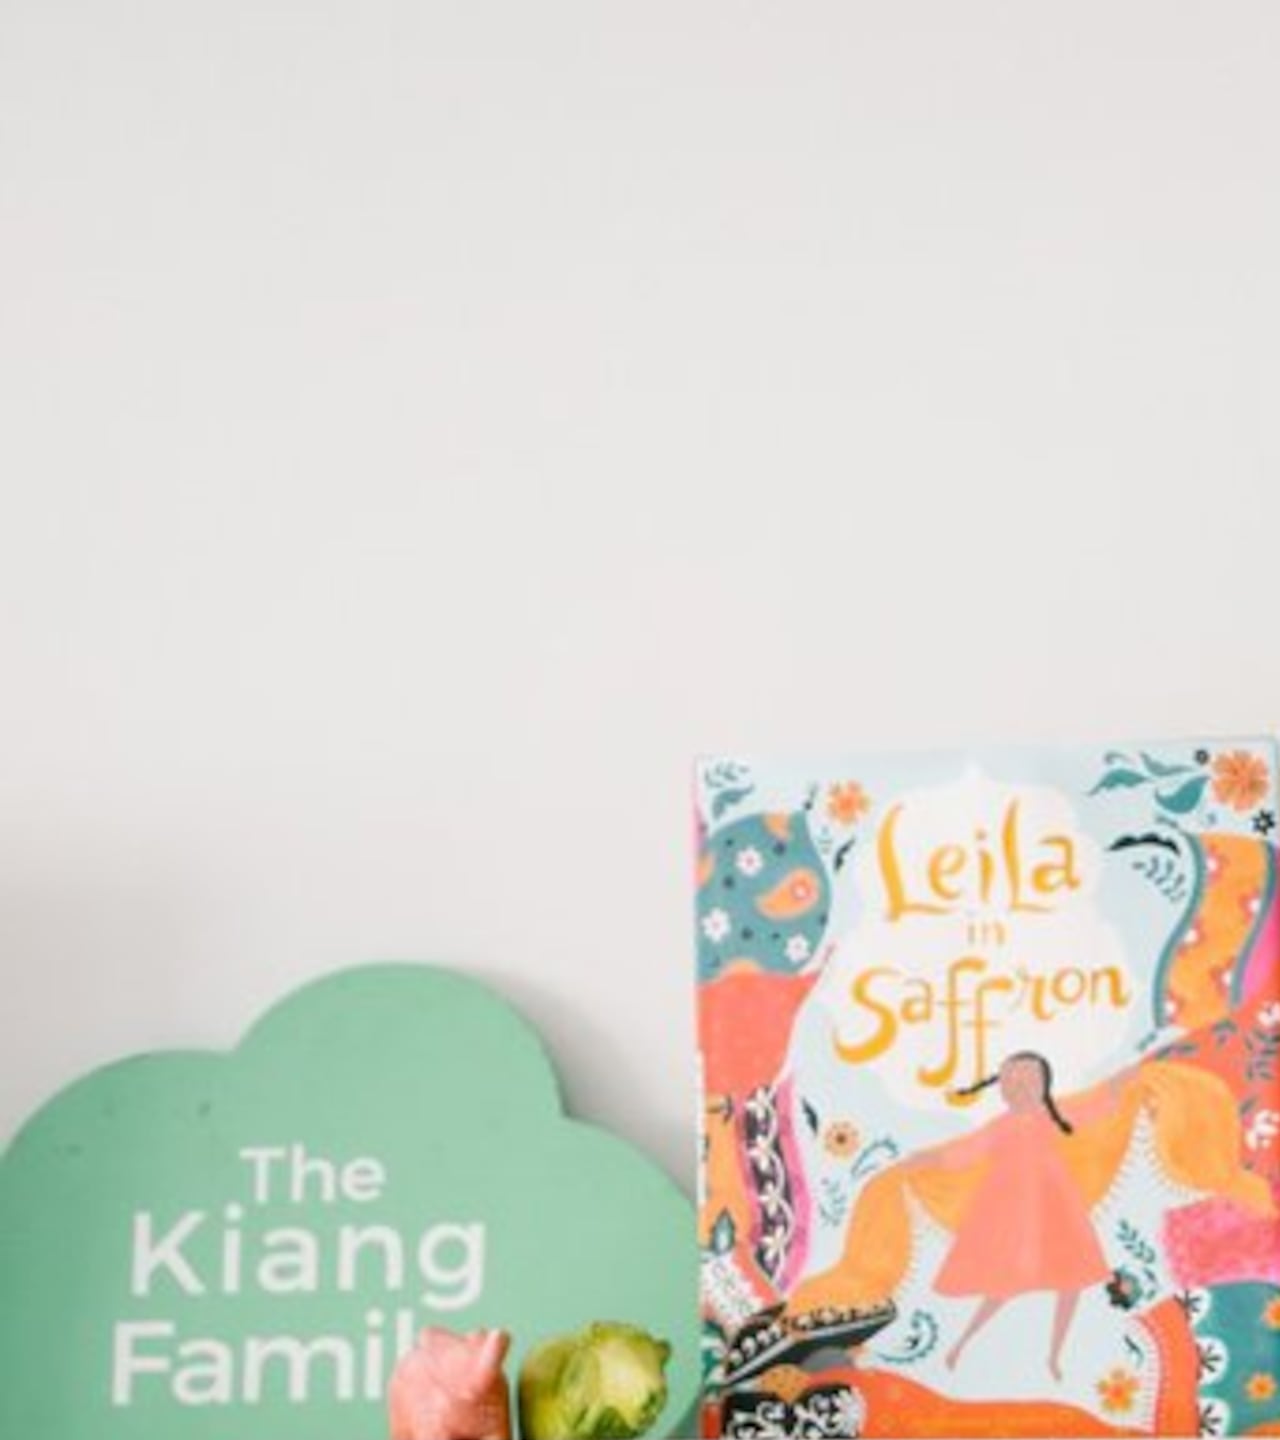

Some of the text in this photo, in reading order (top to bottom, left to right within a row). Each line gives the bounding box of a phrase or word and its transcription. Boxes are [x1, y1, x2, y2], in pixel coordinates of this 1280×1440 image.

[877, 797, 1080, 922] Leila
[969, 922, 1006, 945] in
[833, 956, 1131, 1107] Saffron
[239, 1144, 386, 1202] The
[131, 1203, 486, 1309] Kiang
[111, 1309, 416, 1405] Famil
